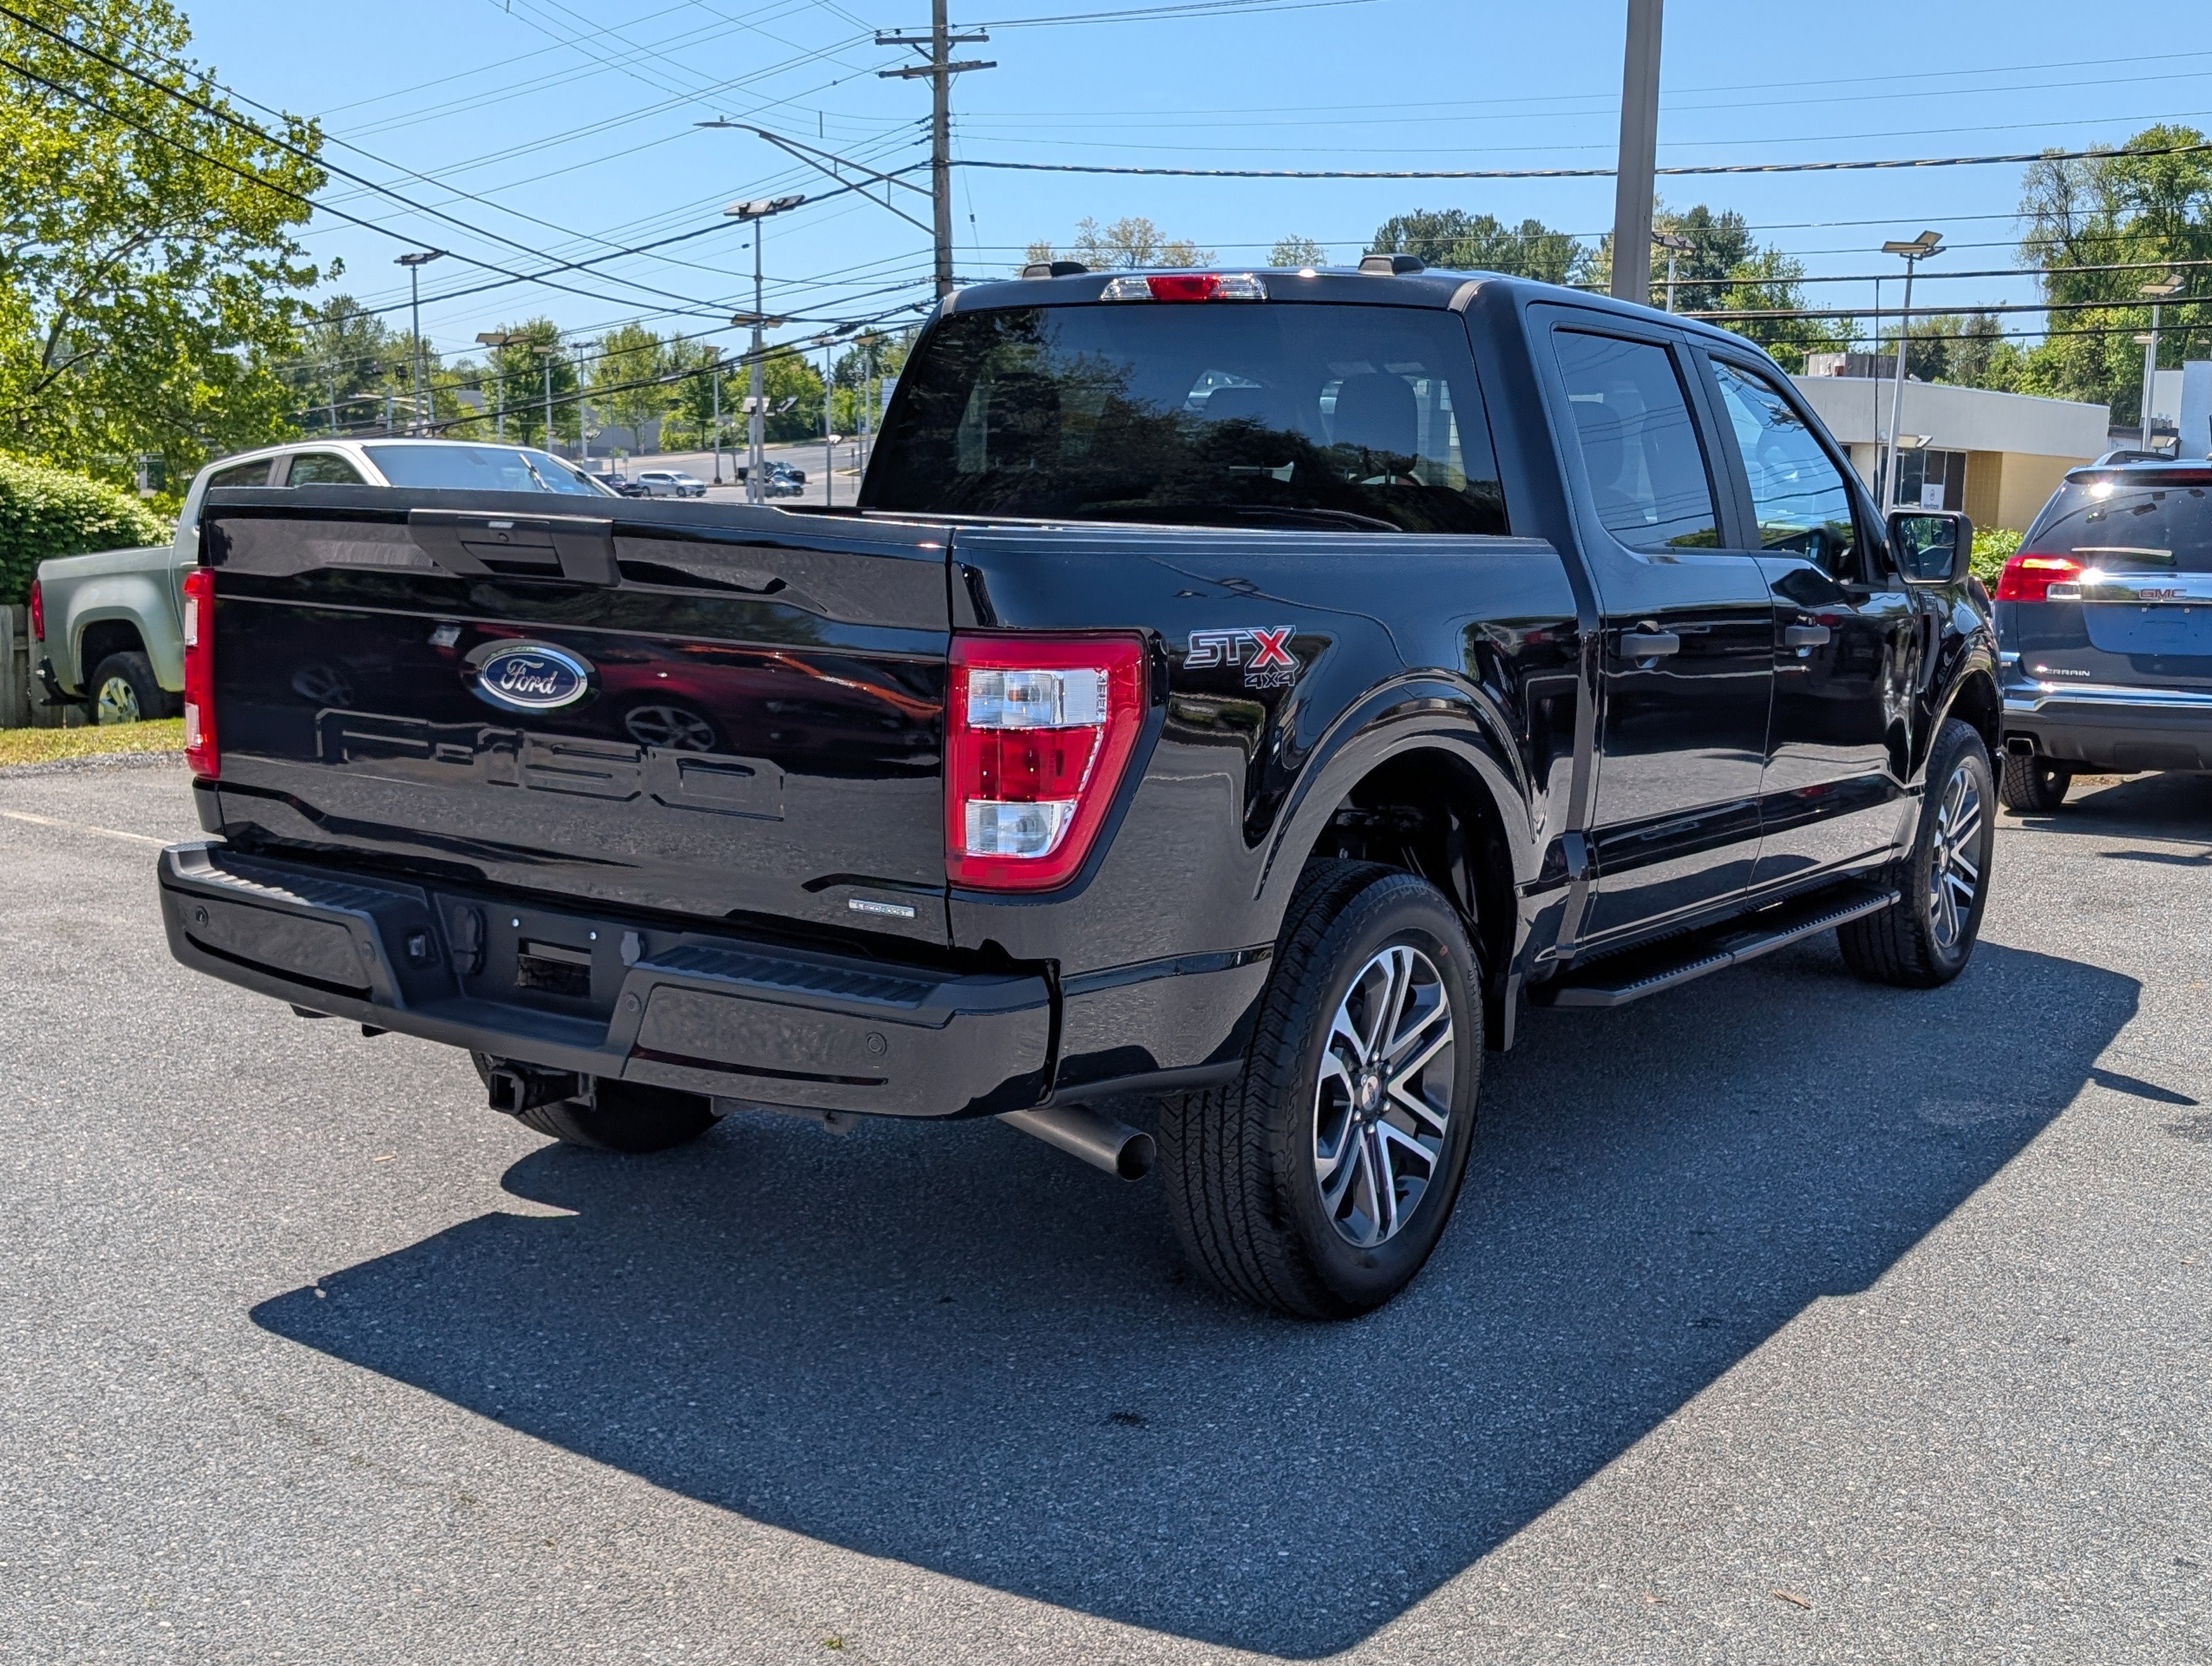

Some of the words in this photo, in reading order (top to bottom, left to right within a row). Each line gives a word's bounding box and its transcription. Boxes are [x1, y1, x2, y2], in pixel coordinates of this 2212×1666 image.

[2139, 588, 2187, 599] GMC
[1184, 625, 1299, 672] STX
[500, 658, 558, 694] Ford
[2036, 667, 2091, 676] ERRAIN
[317, 708, 785, 822] F-150
